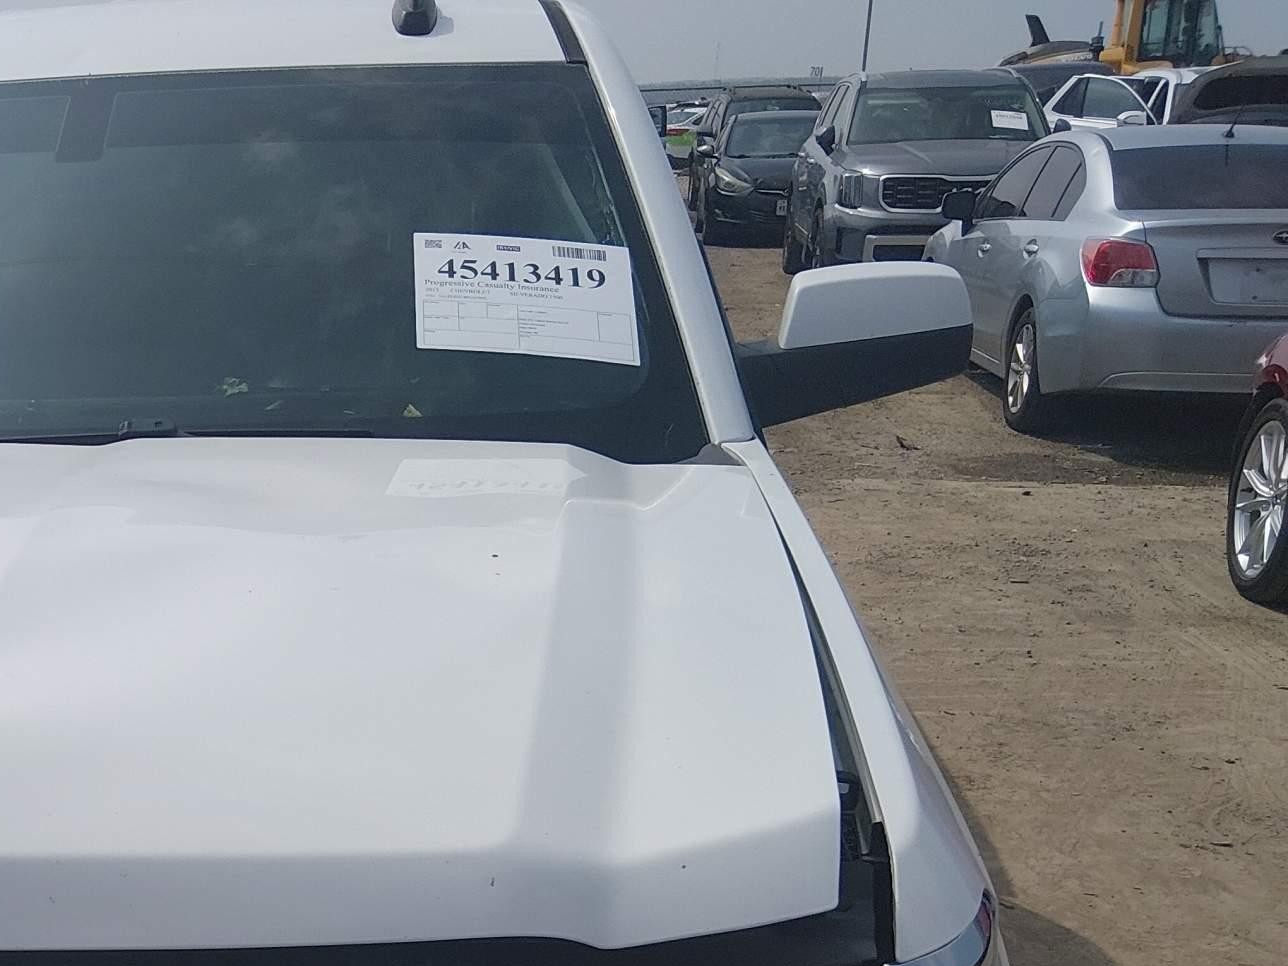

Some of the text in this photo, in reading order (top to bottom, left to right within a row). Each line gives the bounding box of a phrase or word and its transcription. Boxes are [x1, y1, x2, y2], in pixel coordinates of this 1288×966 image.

[437, 258, 606, 289] 45413419
[424, 279, 560, 293] Progressive Casualty Insurance
